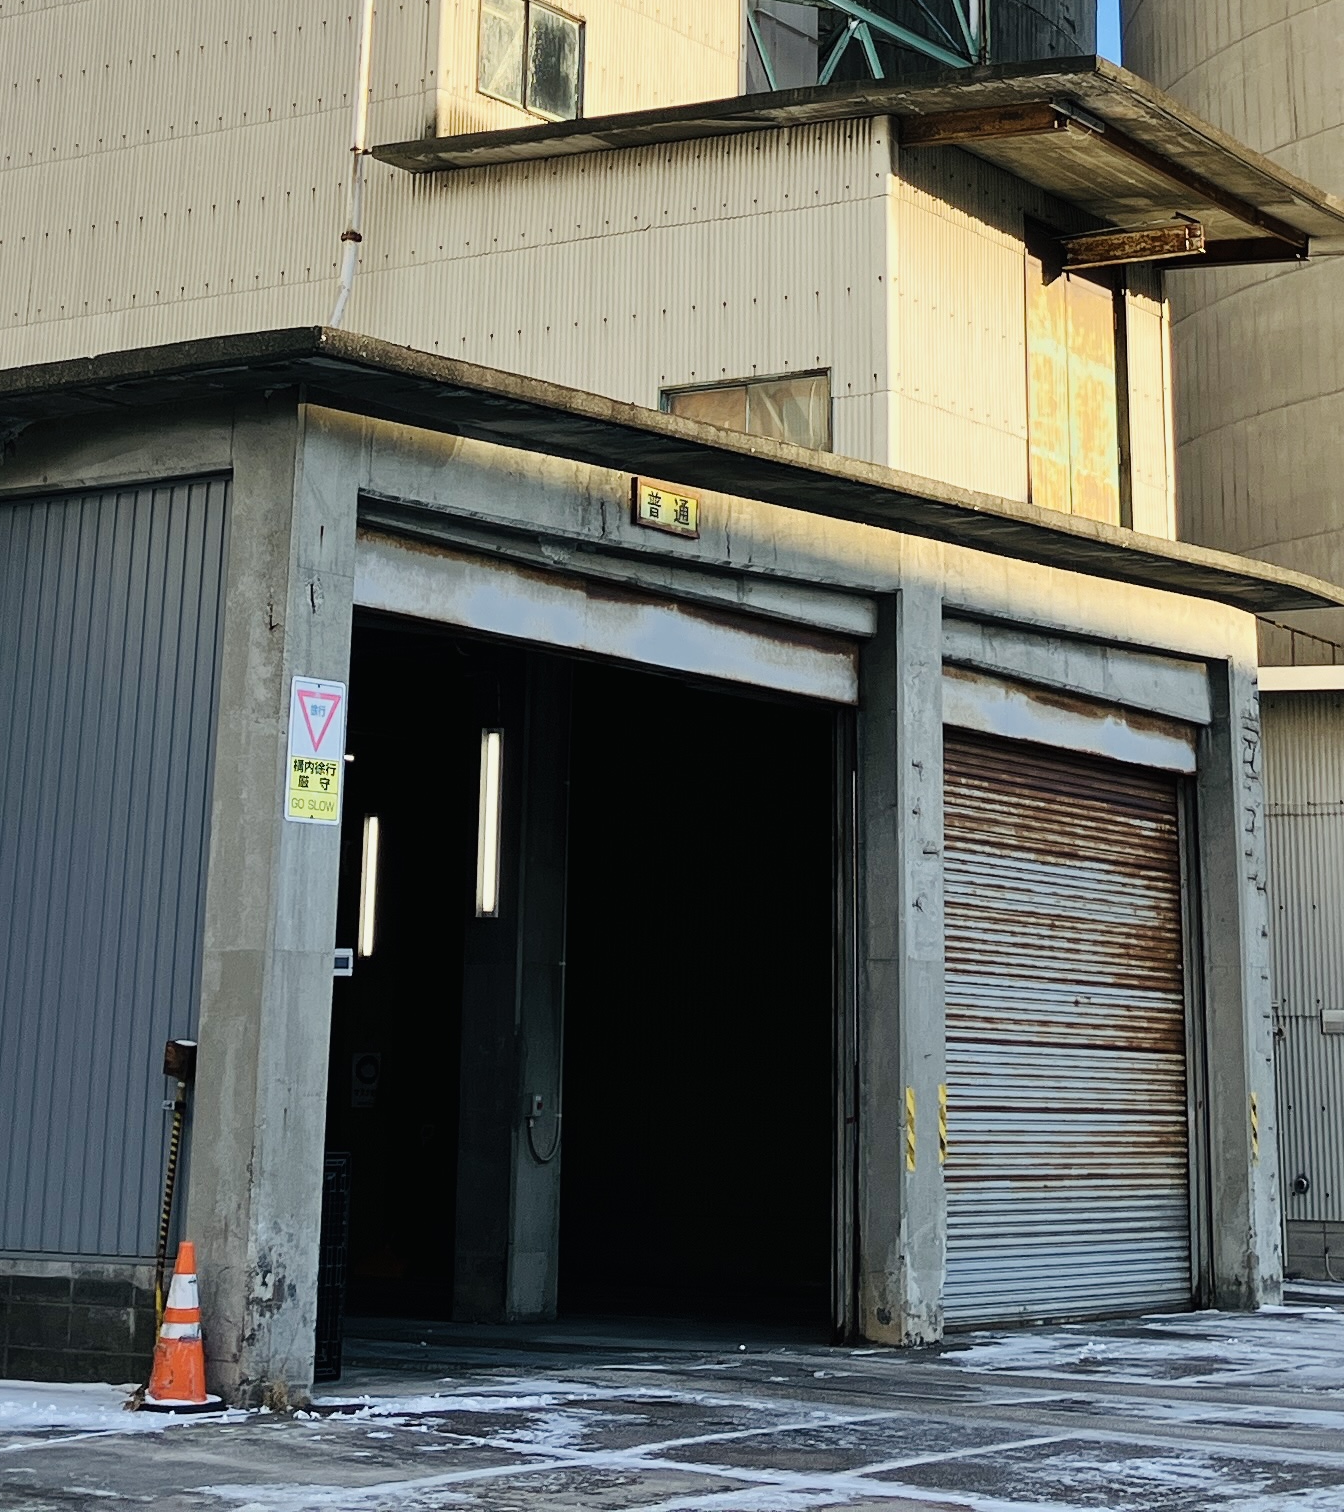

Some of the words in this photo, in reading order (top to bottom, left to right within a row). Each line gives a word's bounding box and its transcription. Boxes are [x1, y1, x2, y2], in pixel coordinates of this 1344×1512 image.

[647, 491, 690, 526] 普通
[293, 758, 337, 777] 構内徐行
[291, 797, 305, 810] GO
[307, 799, 335, 813] SLOW
